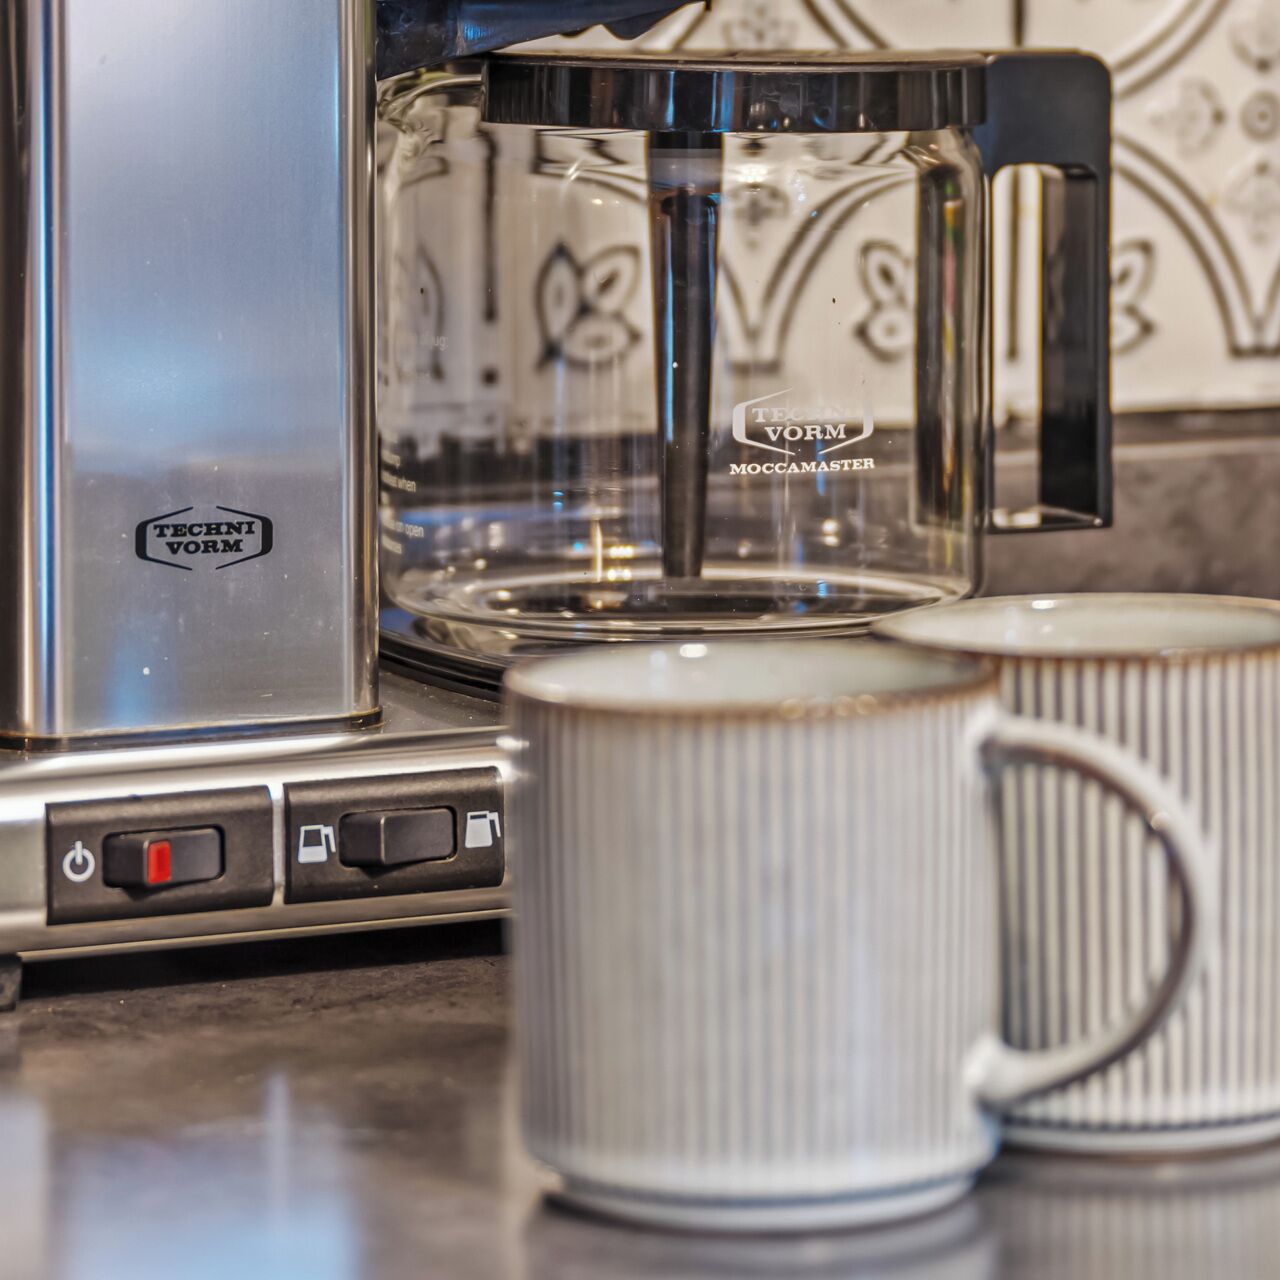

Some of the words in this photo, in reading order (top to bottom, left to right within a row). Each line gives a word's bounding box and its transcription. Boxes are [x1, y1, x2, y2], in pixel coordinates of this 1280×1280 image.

[764, 424, 847, 441] VORM
[729, 458, 876, 475] MOCCAMASTER
[153, 521, 256, 538] TECHNI
[166, 539, 243, 555] VORM
